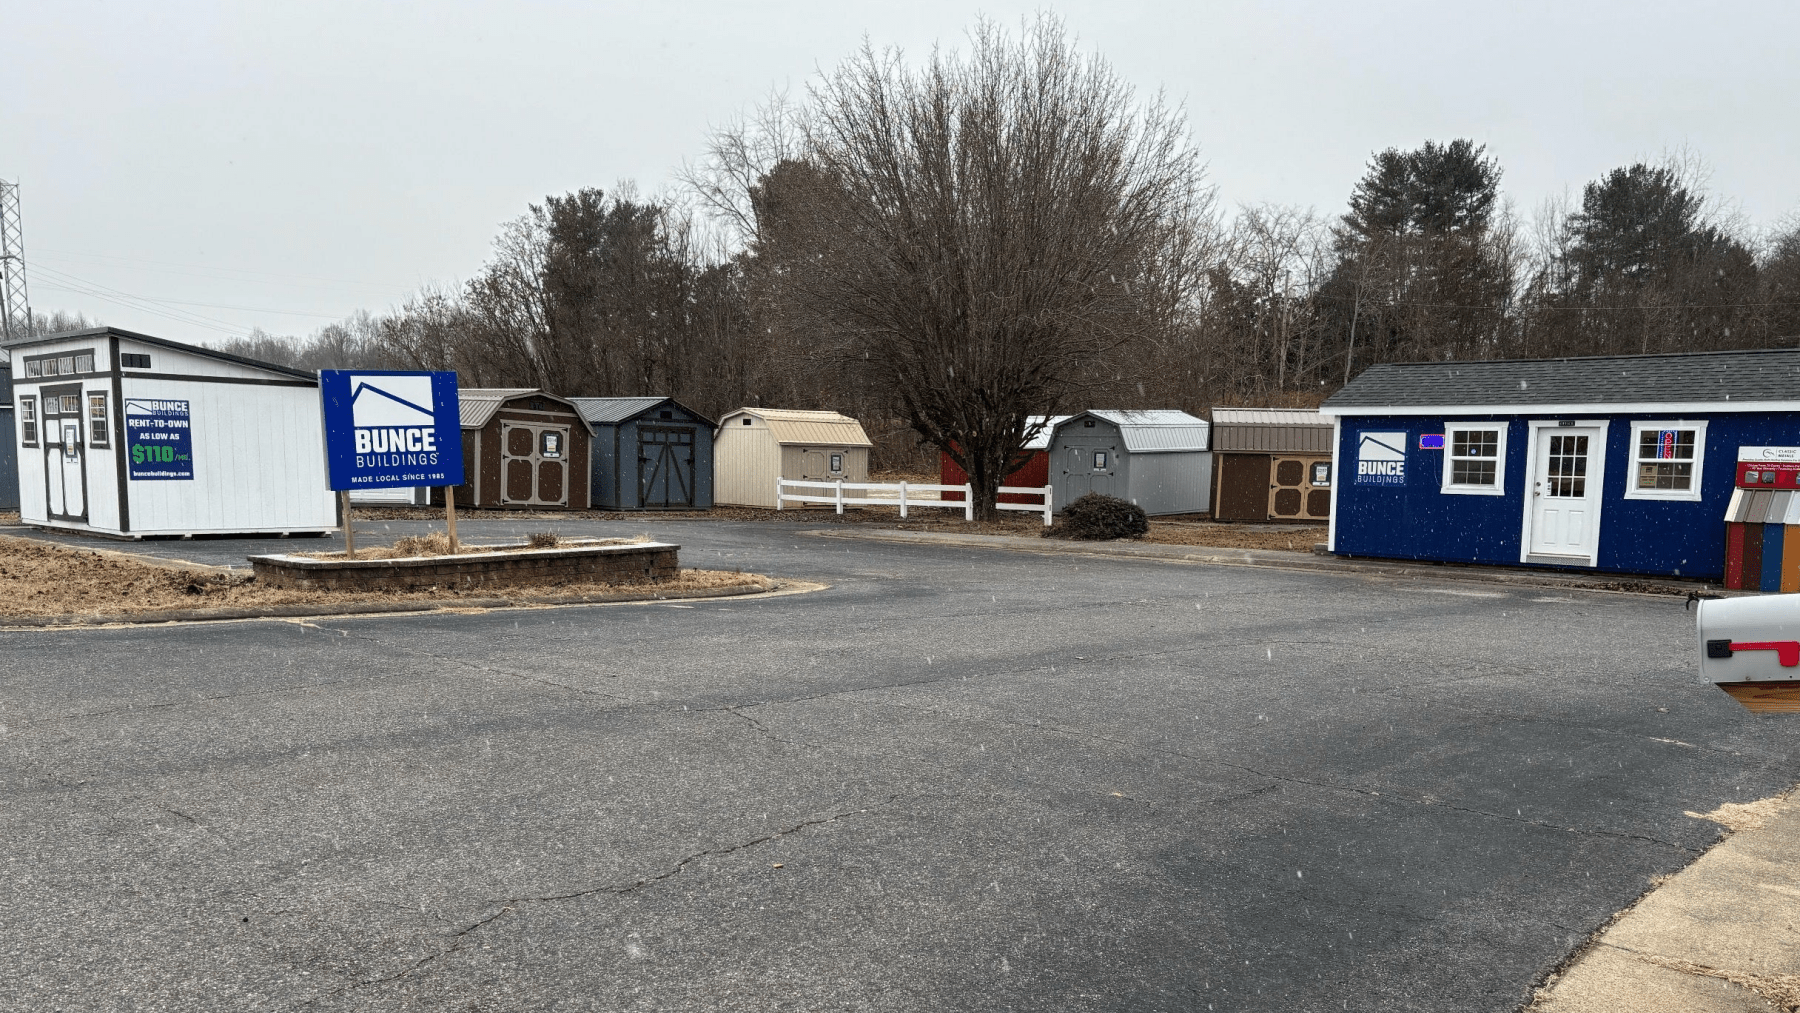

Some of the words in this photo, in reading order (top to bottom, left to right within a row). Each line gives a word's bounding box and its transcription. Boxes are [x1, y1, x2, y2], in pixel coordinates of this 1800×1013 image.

[152, 401, 188, 411] BUNCE
[128, 419, 189, 428] RENT-TO-OWN
[139, 432, 150, 440] AS
[151, 432, 168, 440] LOW
[354, 428, 436, 453] BUNCE
[356, 453, 438, 467] BUILDINGS
[1358, 461, 1405, 475] BUNCE
[375, 474, 400, 482] LOCAL
[402, 473, 426, 481] SINCE
[427, 472, 445, 480] 1985
[1357, 475, 1405, 484] BUILDINGS
